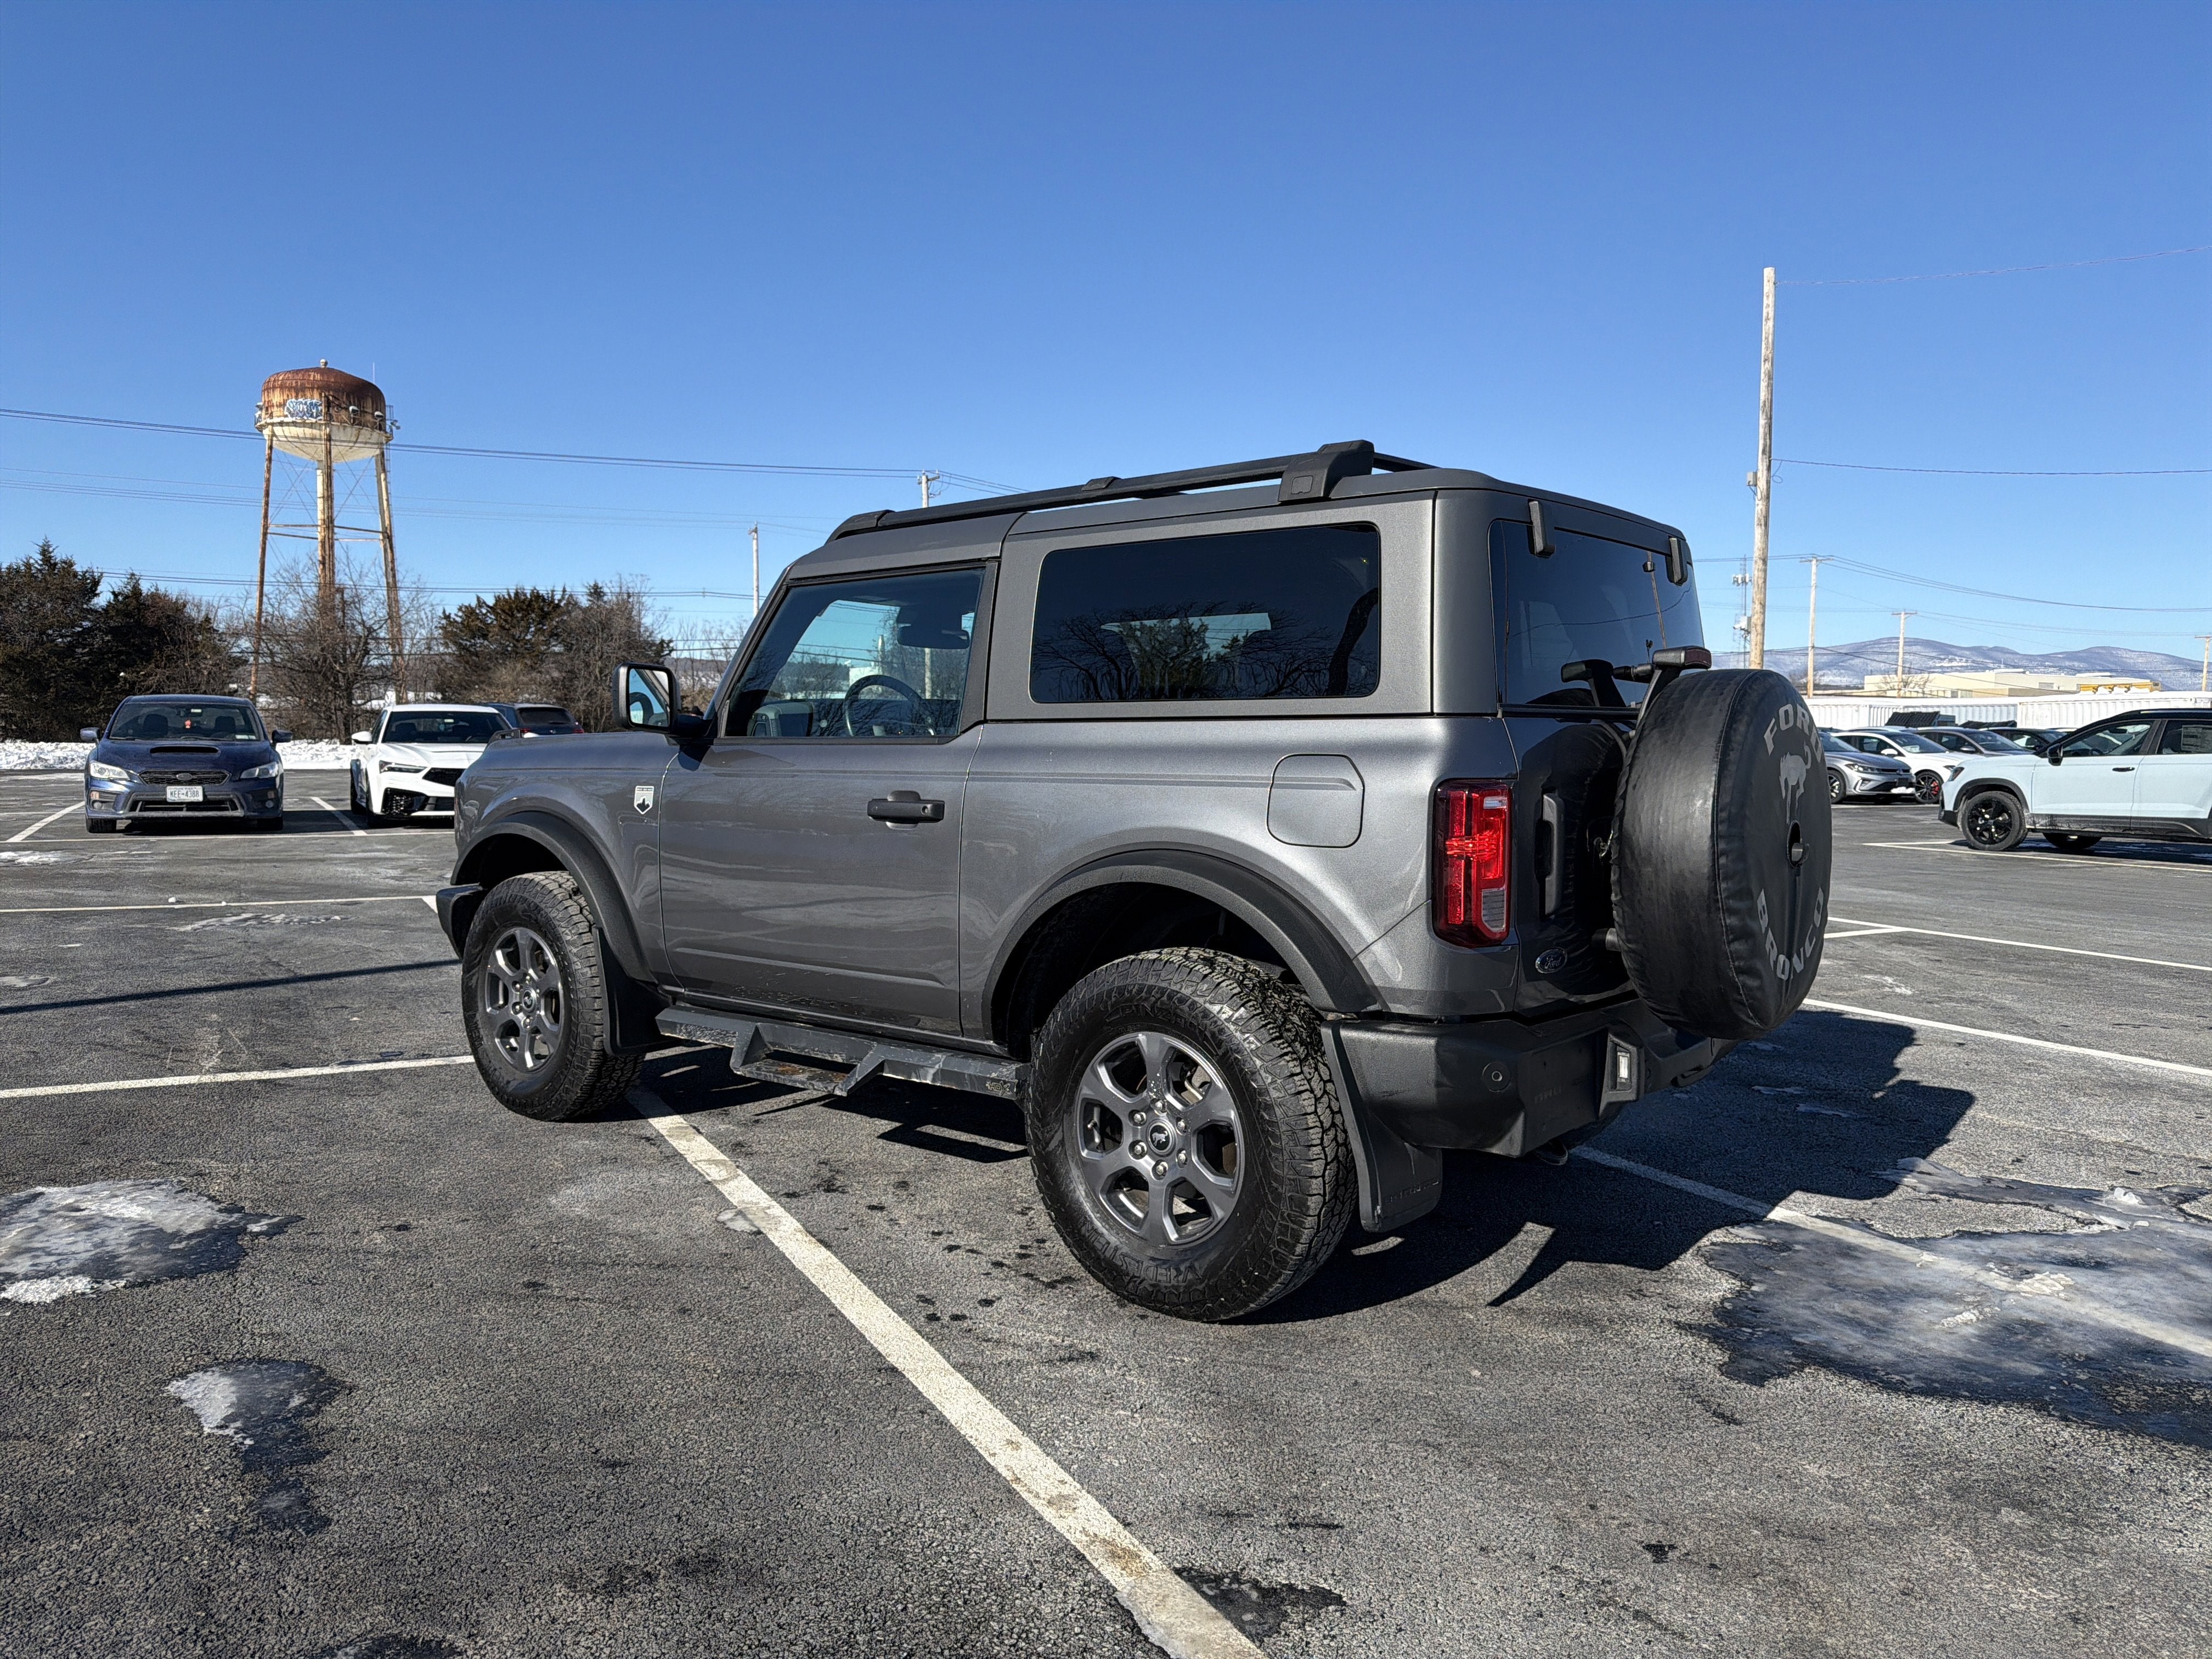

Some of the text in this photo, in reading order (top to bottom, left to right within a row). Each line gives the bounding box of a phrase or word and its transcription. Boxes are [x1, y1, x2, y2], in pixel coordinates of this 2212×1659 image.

[1764, 704, 1822, 763] FORD
[1757, 887, 1824, 981] BRONCO
[1544, 955, 1562, 969] Ford
[986, 1080, 1013, 1096] HDX
